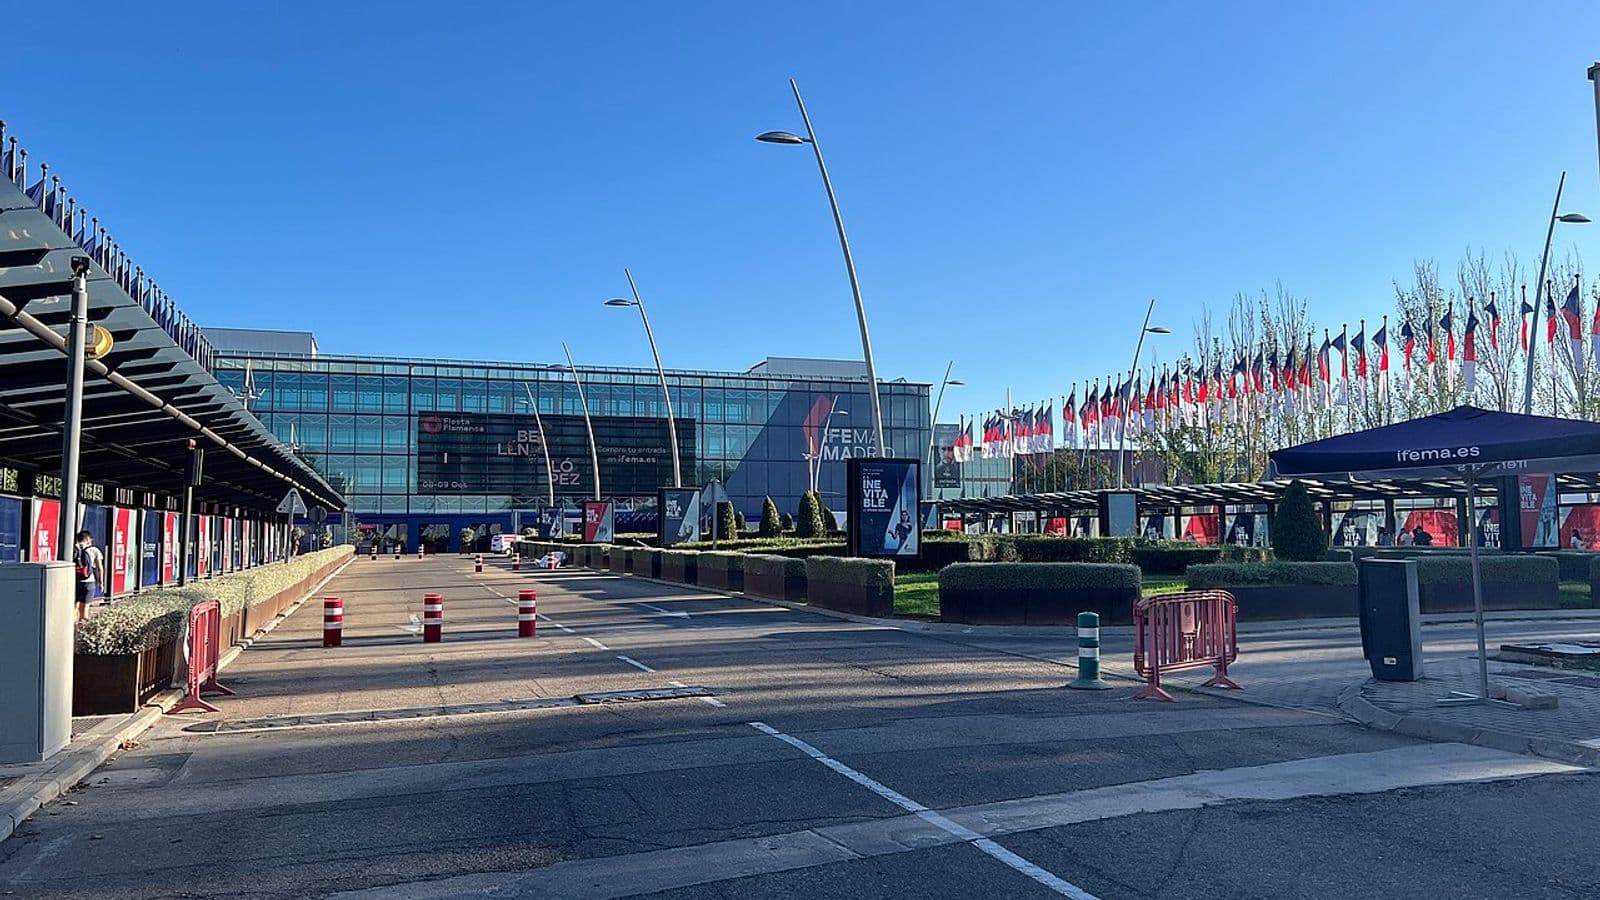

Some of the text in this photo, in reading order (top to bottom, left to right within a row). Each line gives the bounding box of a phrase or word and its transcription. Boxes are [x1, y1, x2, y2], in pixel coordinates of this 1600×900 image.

[517, 430, 538, 442] BE
[823, 445, 896, 461] MADRD
[1397, 446, 1480, 462] ifema.es
[862, 479, 881, 489] INE
[863, 489, 889, 499] VITA
[863, 498, 886, 508] BLE
[1484, 532, 1500, 541] VIT
